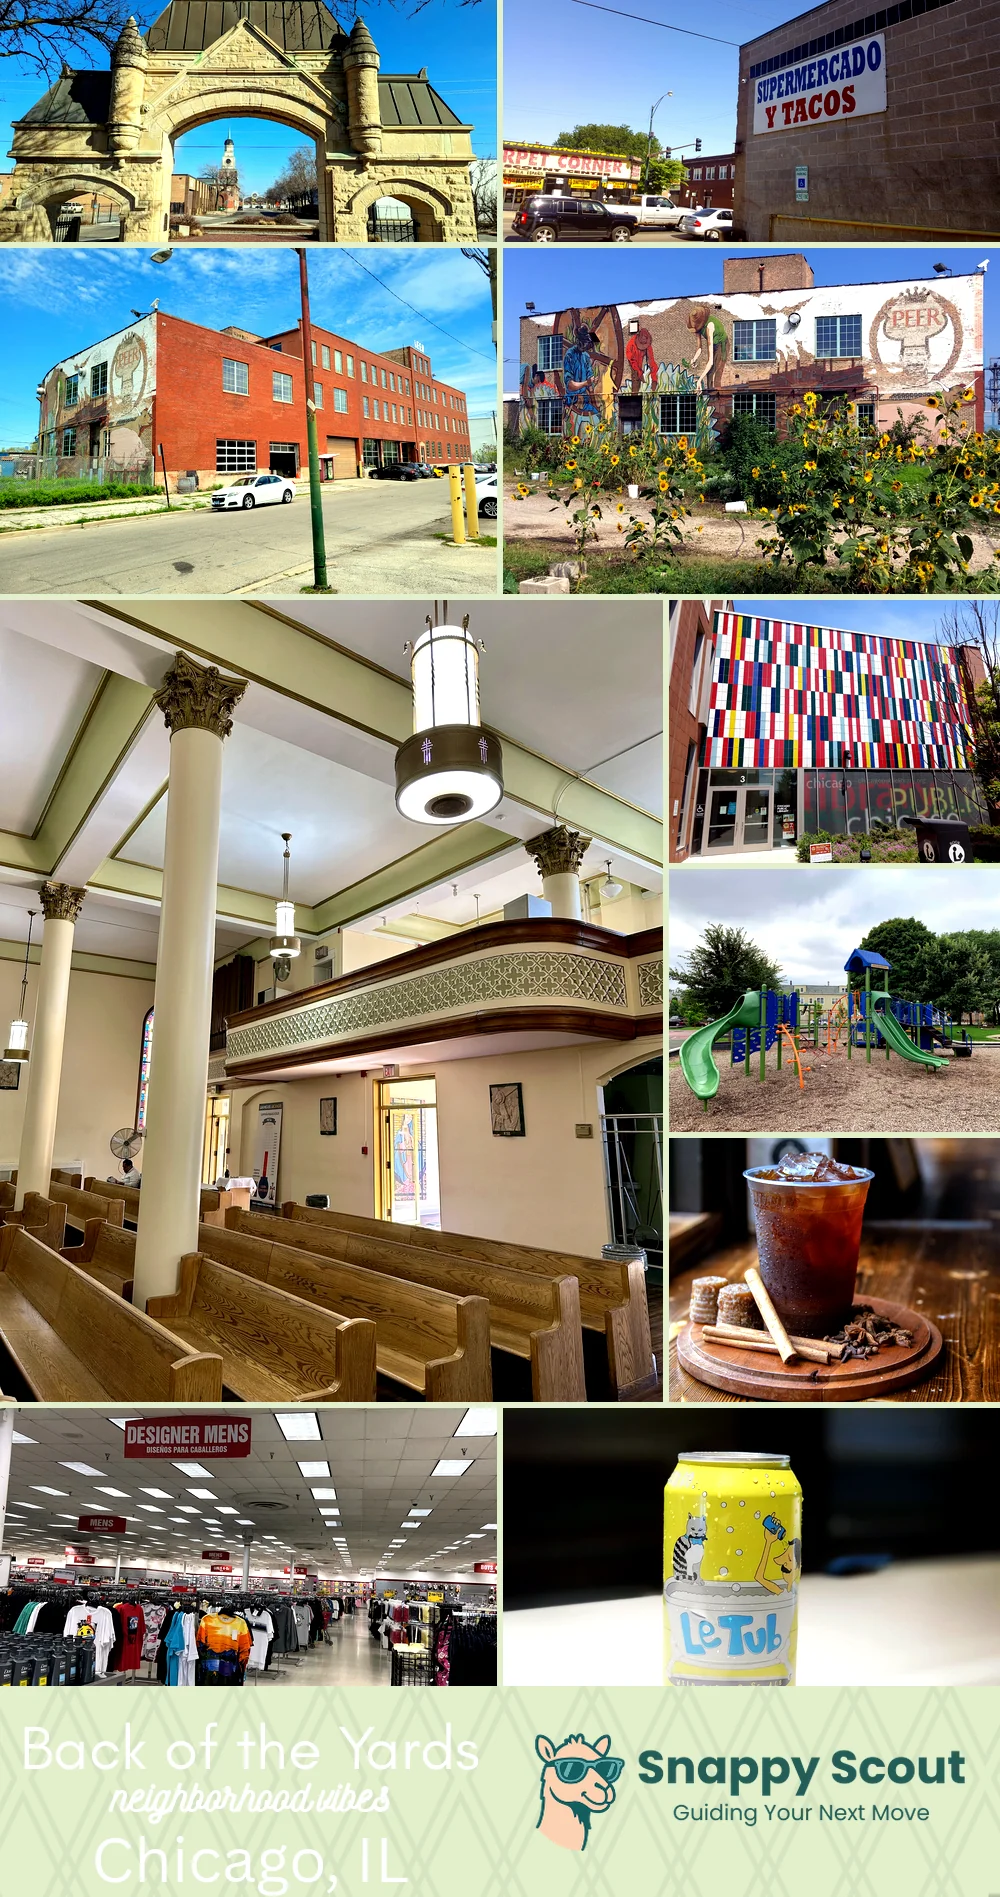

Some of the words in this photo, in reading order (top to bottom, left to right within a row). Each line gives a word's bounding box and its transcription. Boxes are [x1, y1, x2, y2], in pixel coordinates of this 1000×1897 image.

[757, 40, 882, 104] SUPERMERCADO
[765, 105, 777, 129] Y
[782, 84, 857, 126] TACOS
[503, 149, 550, 167] RPET
[558, 154, 622, 174] CORNER
[566, 169, 611, 177] CENTER
[892, 307, 942, 329] PEER
[118, 347, 139, 370] PEER
[740, 775, 746, 783] 3
[806, 776, 852, 795] chicago
[890, 786, 990, 816] PUBLIC
[127, 1425, 200, 1444] DESIGNER
[204, 1423, 249, 1443] MENS
[146, 1445, 172, 1454] DISEÑOS
[173, 1446, 189, 1454] PARA
[190, 1445, 228, 1453] CABALLEROS
[90, 1518, 114, 1527] MENS
[679, 1611, 722, 1656] Le
[717, 1613, 782, 1657] Tub
